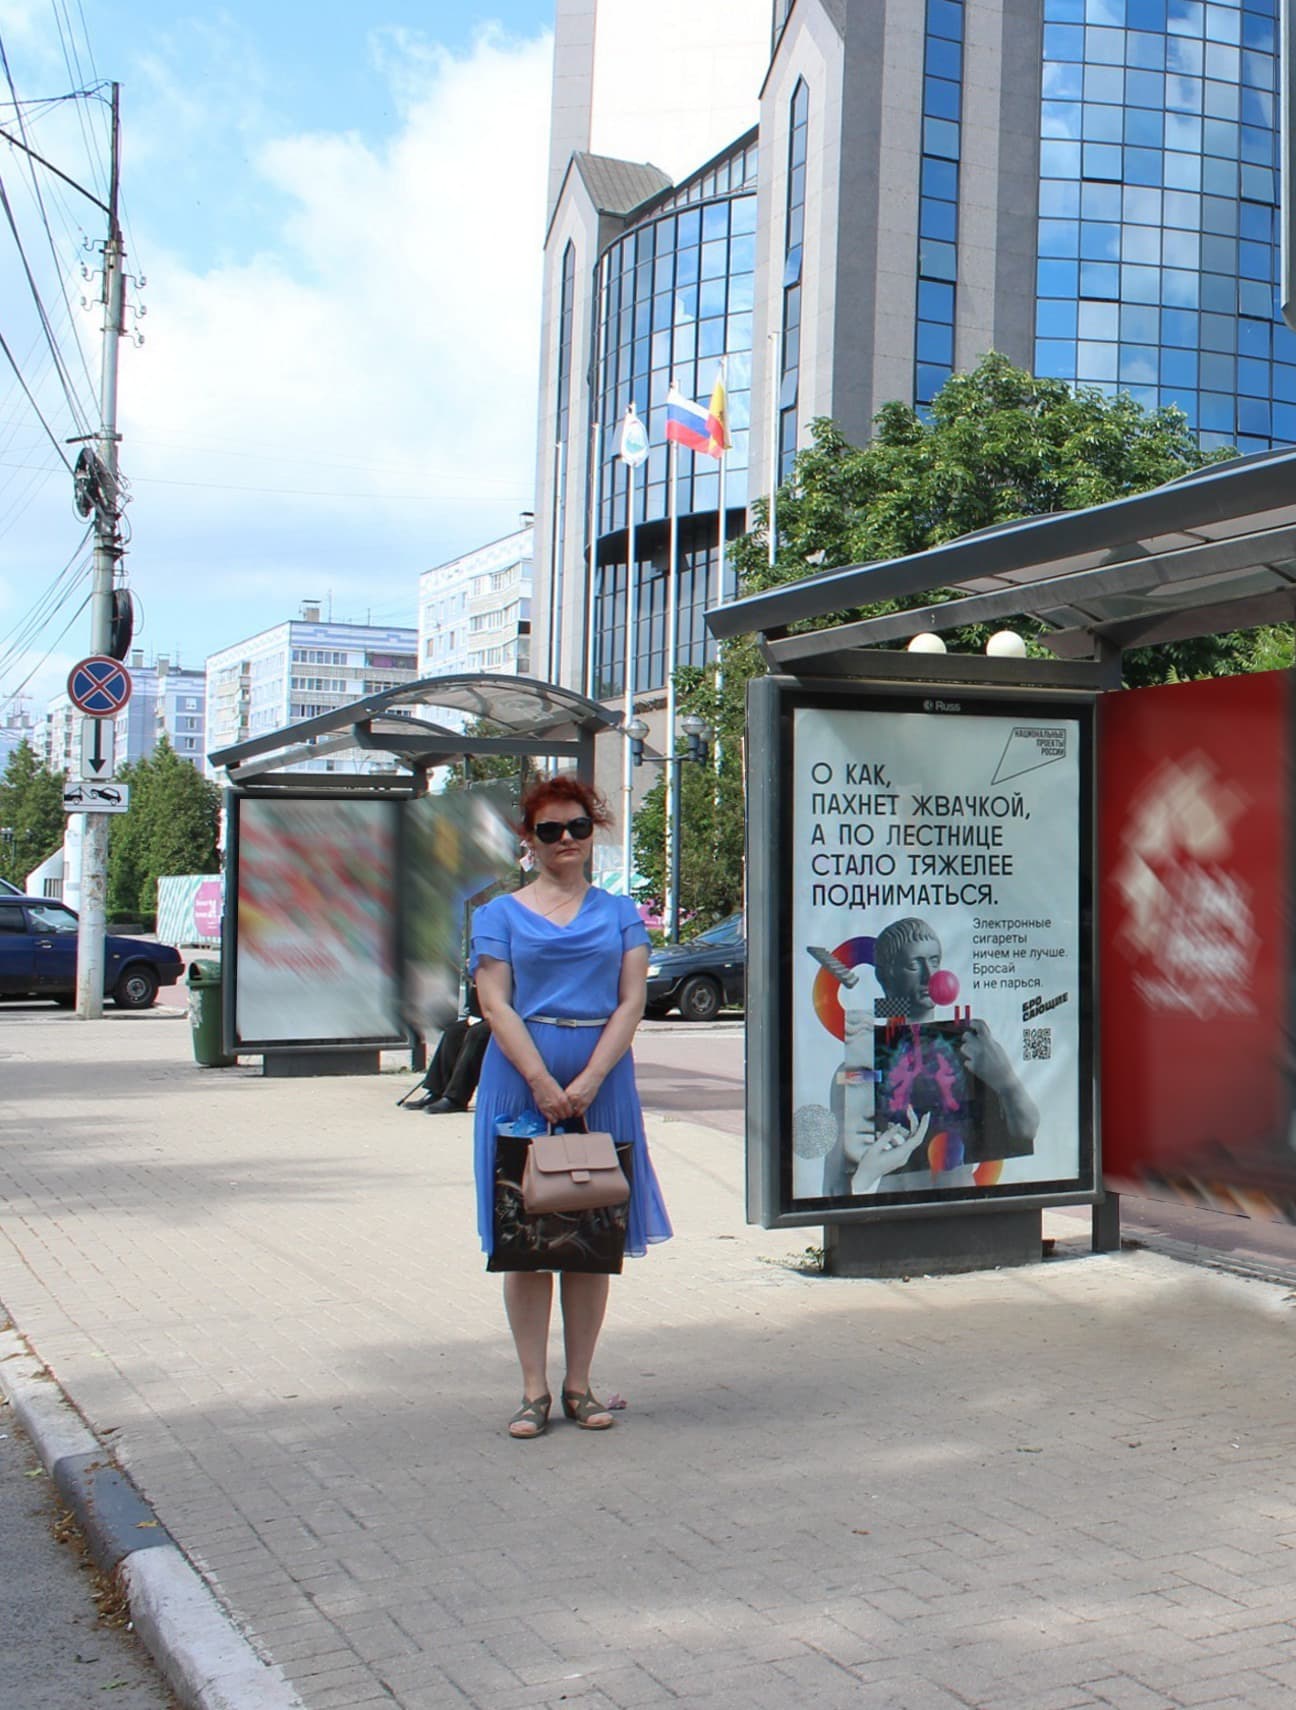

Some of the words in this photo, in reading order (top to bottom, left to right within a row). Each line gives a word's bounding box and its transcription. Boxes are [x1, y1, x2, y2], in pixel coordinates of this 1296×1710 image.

[811, 762, 833, 785] О
[846, 763, 892, 789] КАК,
[812, 793, 900, 816] ПАХНЕТ
[911, 791, 1031, 821] ЖВАЧКОЙ,
[811, 823, 826, 846] А
[839, 823, 875, 847] ПО
[886, 823, 1004, 850] ЛЕСТНИЦЕ
[811, 853, 896, 877] СТАЛО
[907, 854, 1014, 876] ТЯЖЕЛЕЕ
[812, 883, 999, 910] ПОДНИМАТЬСЯ.
[973, 917, 1052, 930] Электронные
[972, 934, 1028, 946] сигареты
[973, 949, 1010, 959] ничем
[1013, 948, 1027, 959] не
[1029, 948, 1068, 960] лучше.
[973, 962, 1016, 976] Бросай
[973, 980, 981, 990] и
[983, 979, 998, 989] не
[1000, 979, 1044, 990] парься.
[1022, 995, 1042, 1012] БРО
